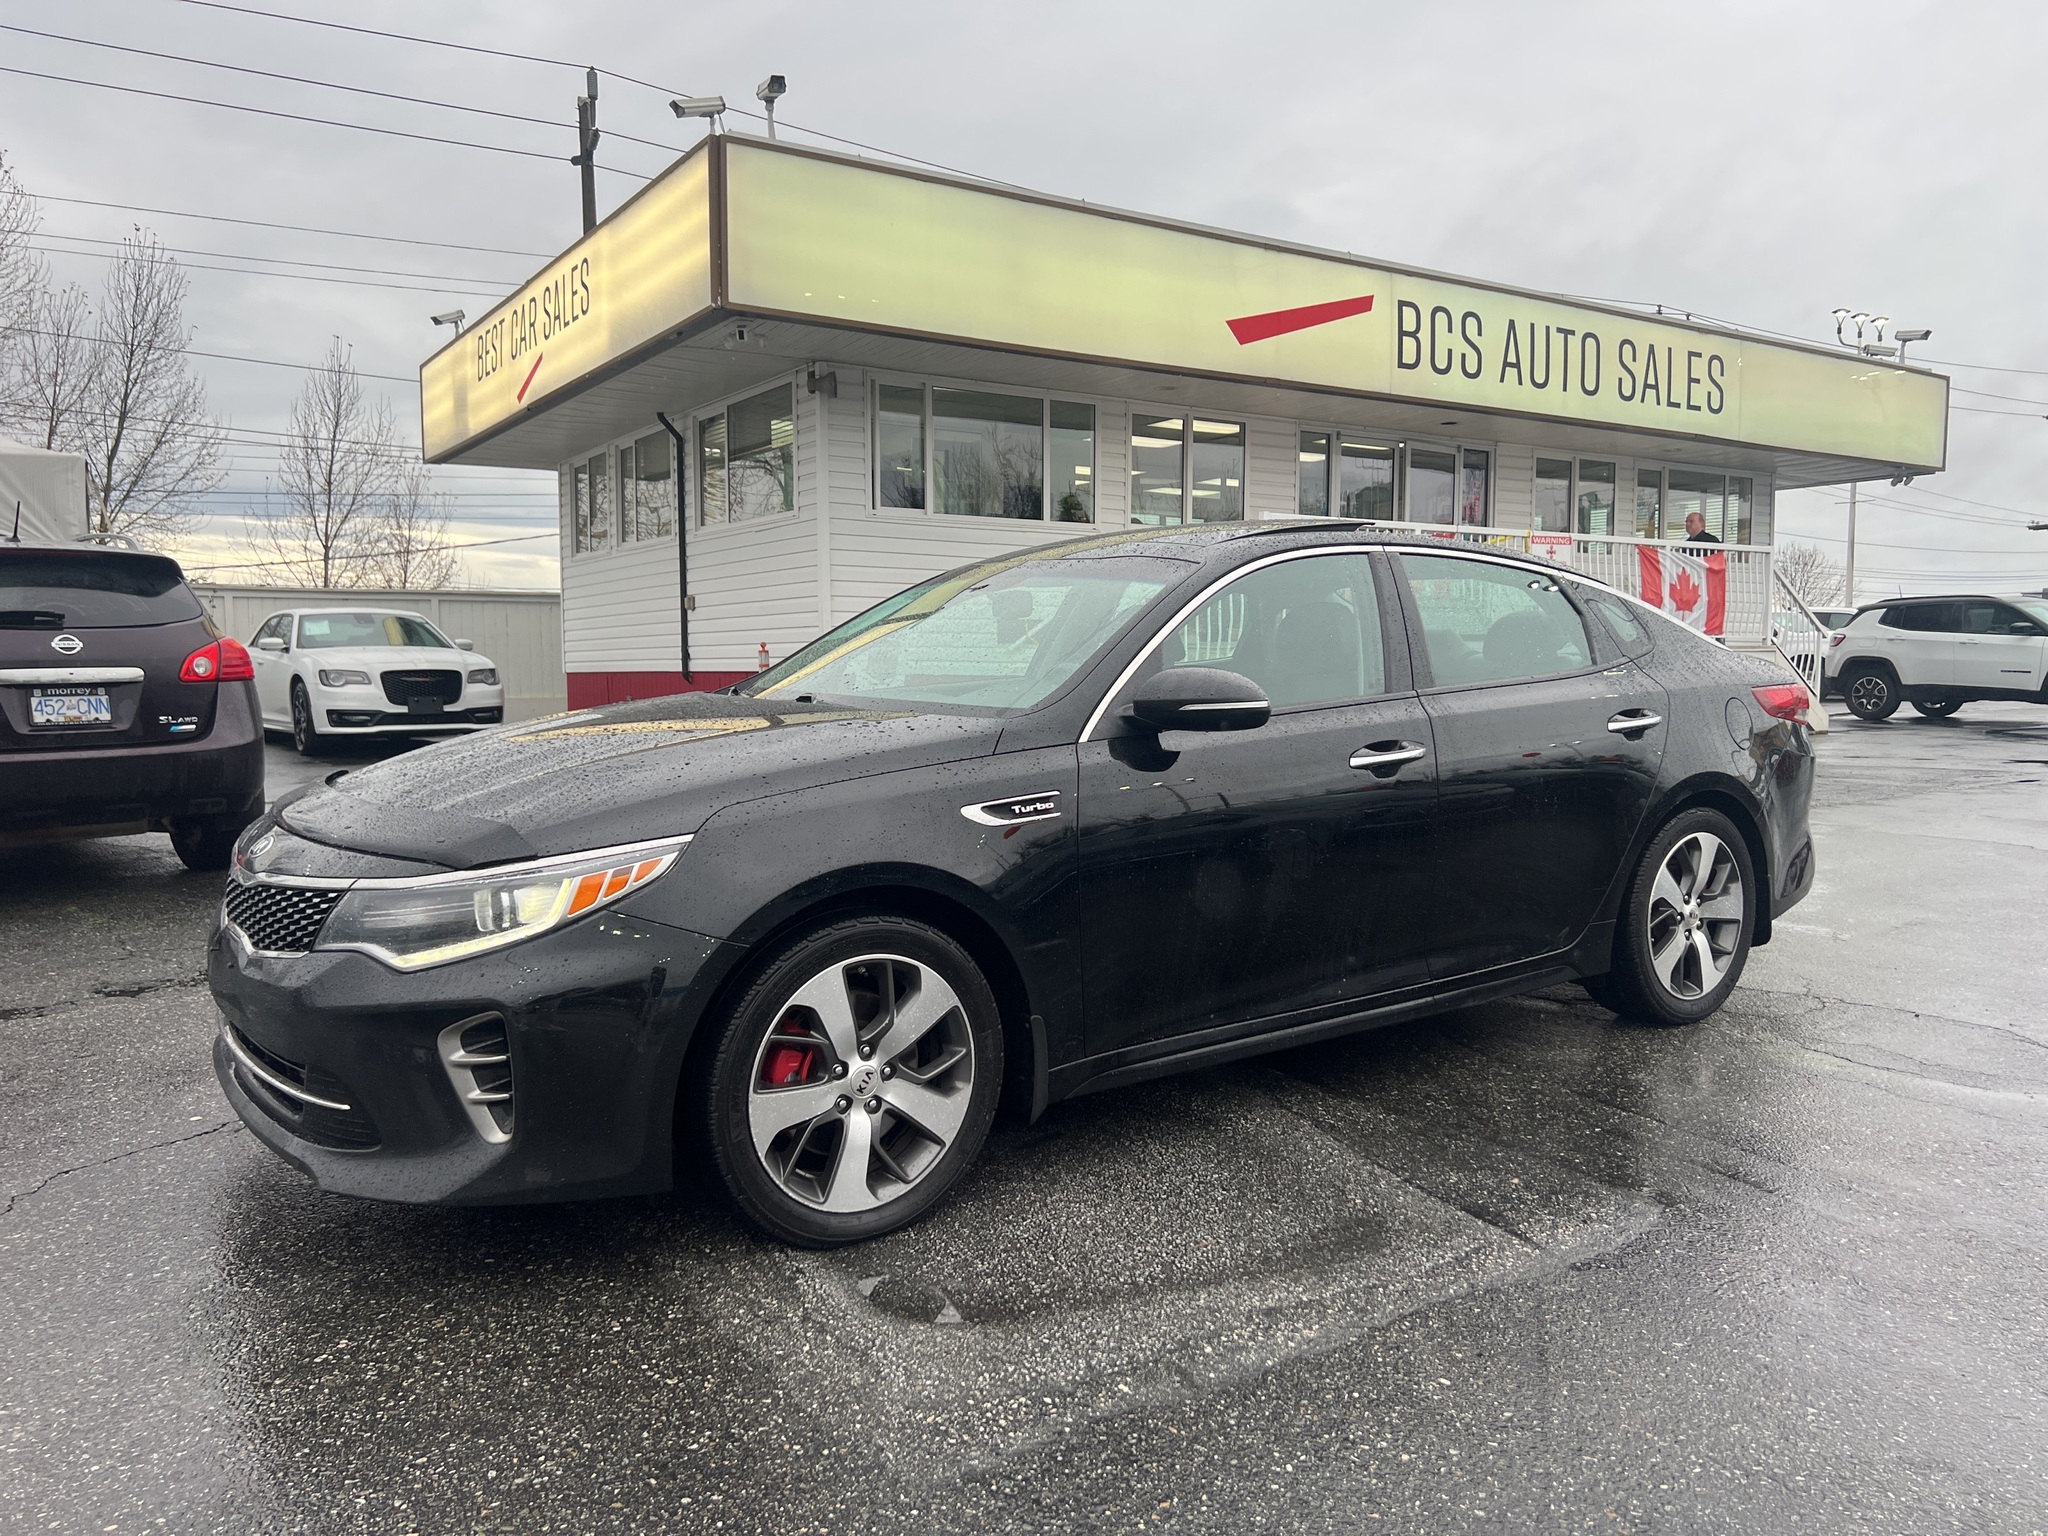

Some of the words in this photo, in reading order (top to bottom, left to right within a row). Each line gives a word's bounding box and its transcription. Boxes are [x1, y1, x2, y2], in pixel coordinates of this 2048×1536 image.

[477, 317, 505, 382] BEST
[510, 296, 538, 361] CAR
[543, 257, 590, 341] SALES
[1397, 299, 1483, 380] BCS
[1499, 318, 1600, 396] AUTO
[1617, 338, 1725, 415] SALES
[1532, 536, 1570, 545] WARNING
[47, 687, 91, 695] morrey
[33, 698, 67, 716] 452
[77, 698, 110, 715] CNN
[1011, 802, 1055, 814] Turbo
[856, 1070, 874, 1094] KIA
